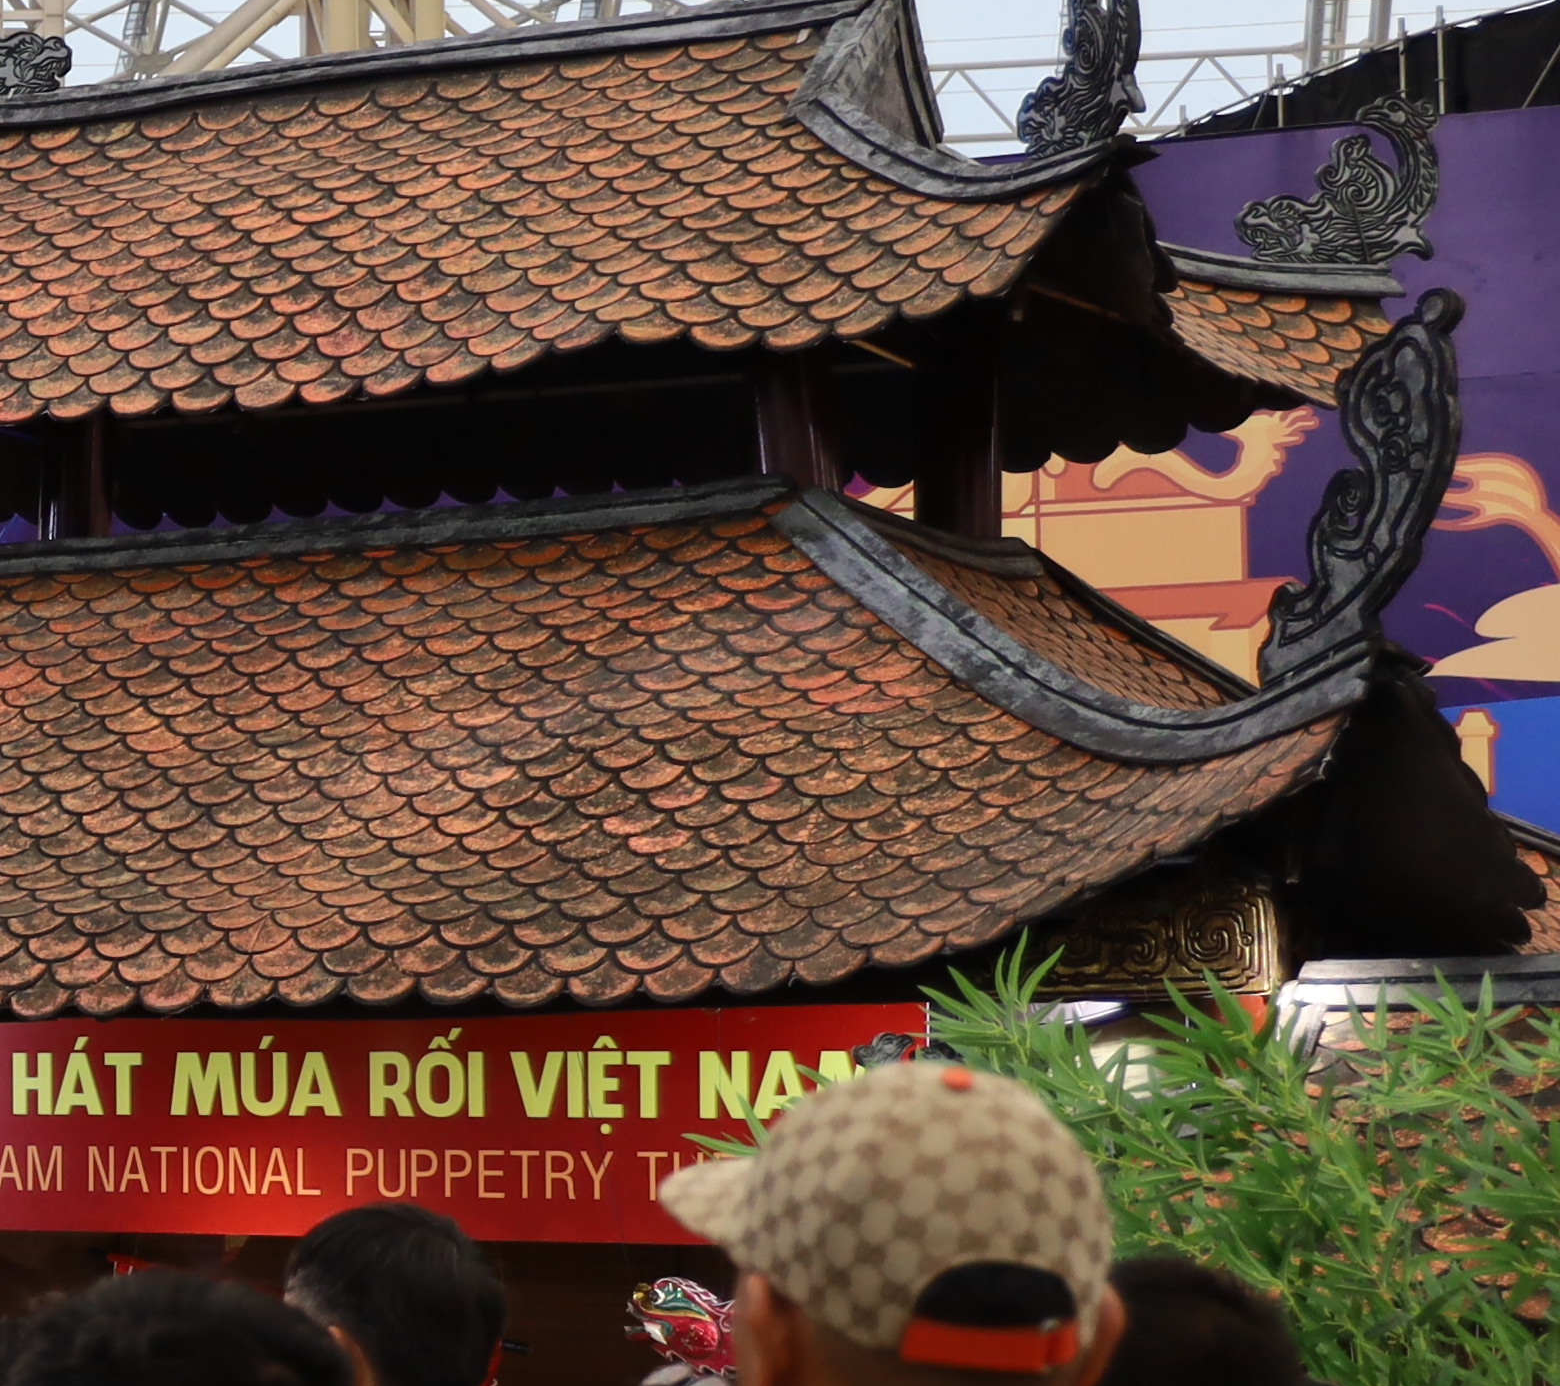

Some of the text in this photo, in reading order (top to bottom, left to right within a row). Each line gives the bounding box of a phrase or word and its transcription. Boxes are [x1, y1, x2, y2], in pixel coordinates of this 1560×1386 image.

[12, 1036, 142, 1116] HÁT
[170, 1035, 342, 1117] MÚA
[368, 1027, 487, 1118] RỐI
[510, 1035, 672, 1135] VIỆT
[88, 1145, 322, 1196] NATIONAL
[345, 1147, 614, 1200] PUPPETRY
